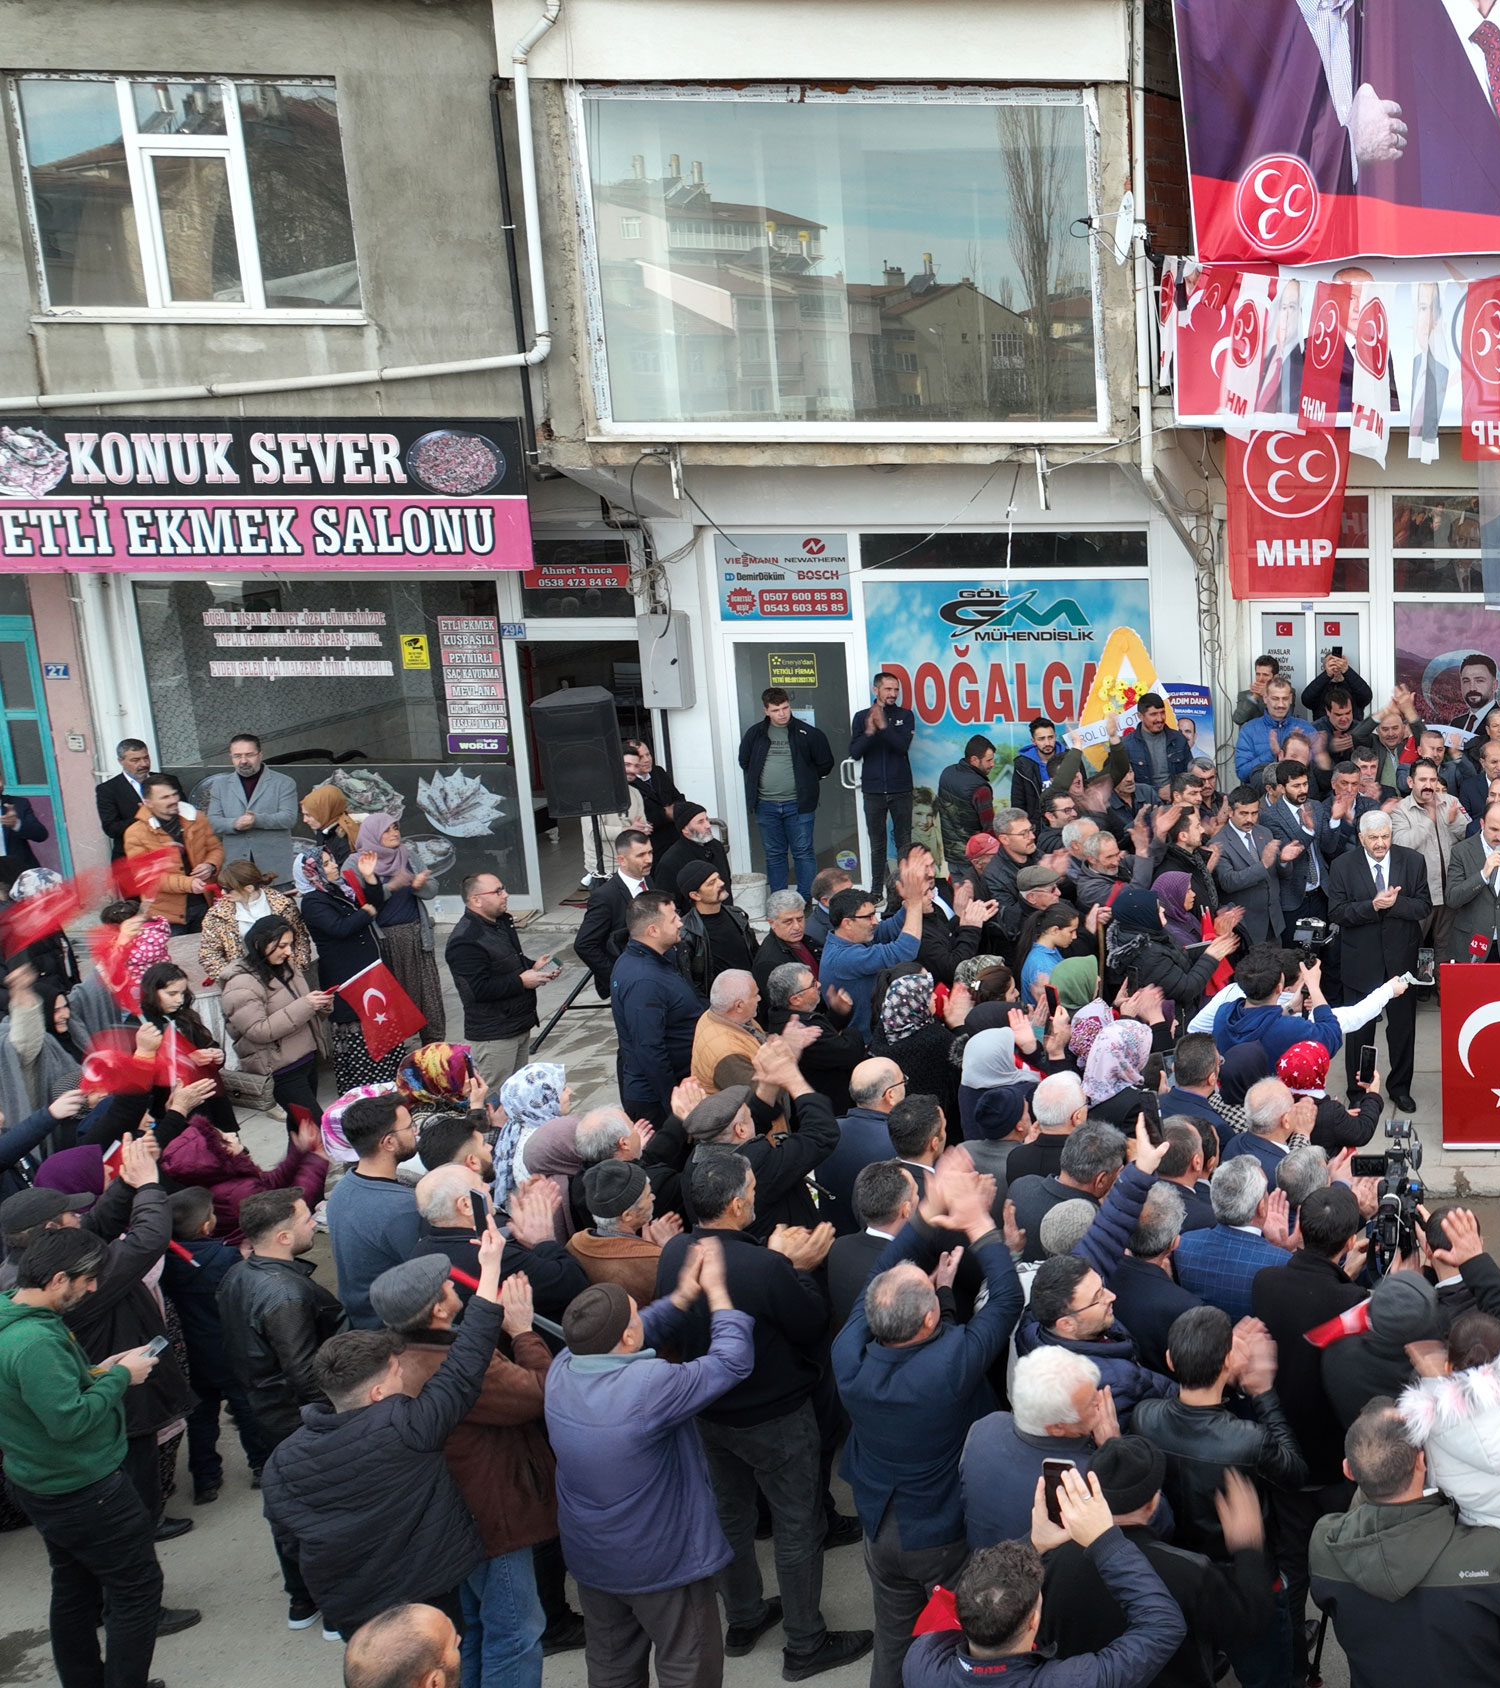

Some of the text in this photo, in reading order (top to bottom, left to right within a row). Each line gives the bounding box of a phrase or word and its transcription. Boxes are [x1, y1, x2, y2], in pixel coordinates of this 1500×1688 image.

[64, 432, 407, 484] KONUK SEVER
[0, 496, 495, 557] ETLİ EKMEK SALONU
[1255, 538, 1333, 567] MHP
[541, 567, 577, 575] Ahmet
[797, 570, 839, 580] BOSCH
[1464, 570, 1489, 578] Columbia
[736, 572, 785, 581] DemirDöküm
[538, 579, 564, 587] 0538
[605, 578, 618, 586] 62
[763, 592, 843, 601] 0507 600 85 83
[958, 588, 1009, 599] GÖL
[763, 603, 844, 612] 0543 603 45 85
[441, 617, 495, 630] ETLİ EKMEK
[974, 628, 1095, 642] MÜHENDİSLİK
[449, 650, 493, 663] PEYNİRLİ
[47, 665, 65, 676] 27
[462, 669, 500, 679] KAVURMA
[881, 645, 1098, 725] DOĞALGA
[451, 686, 497, 696] MEVLANA
[1171, 698, 1189, 706] ADIM
[1080, 730, 1099, 743] ROL
[459, 742, 499, 750] WORLD
